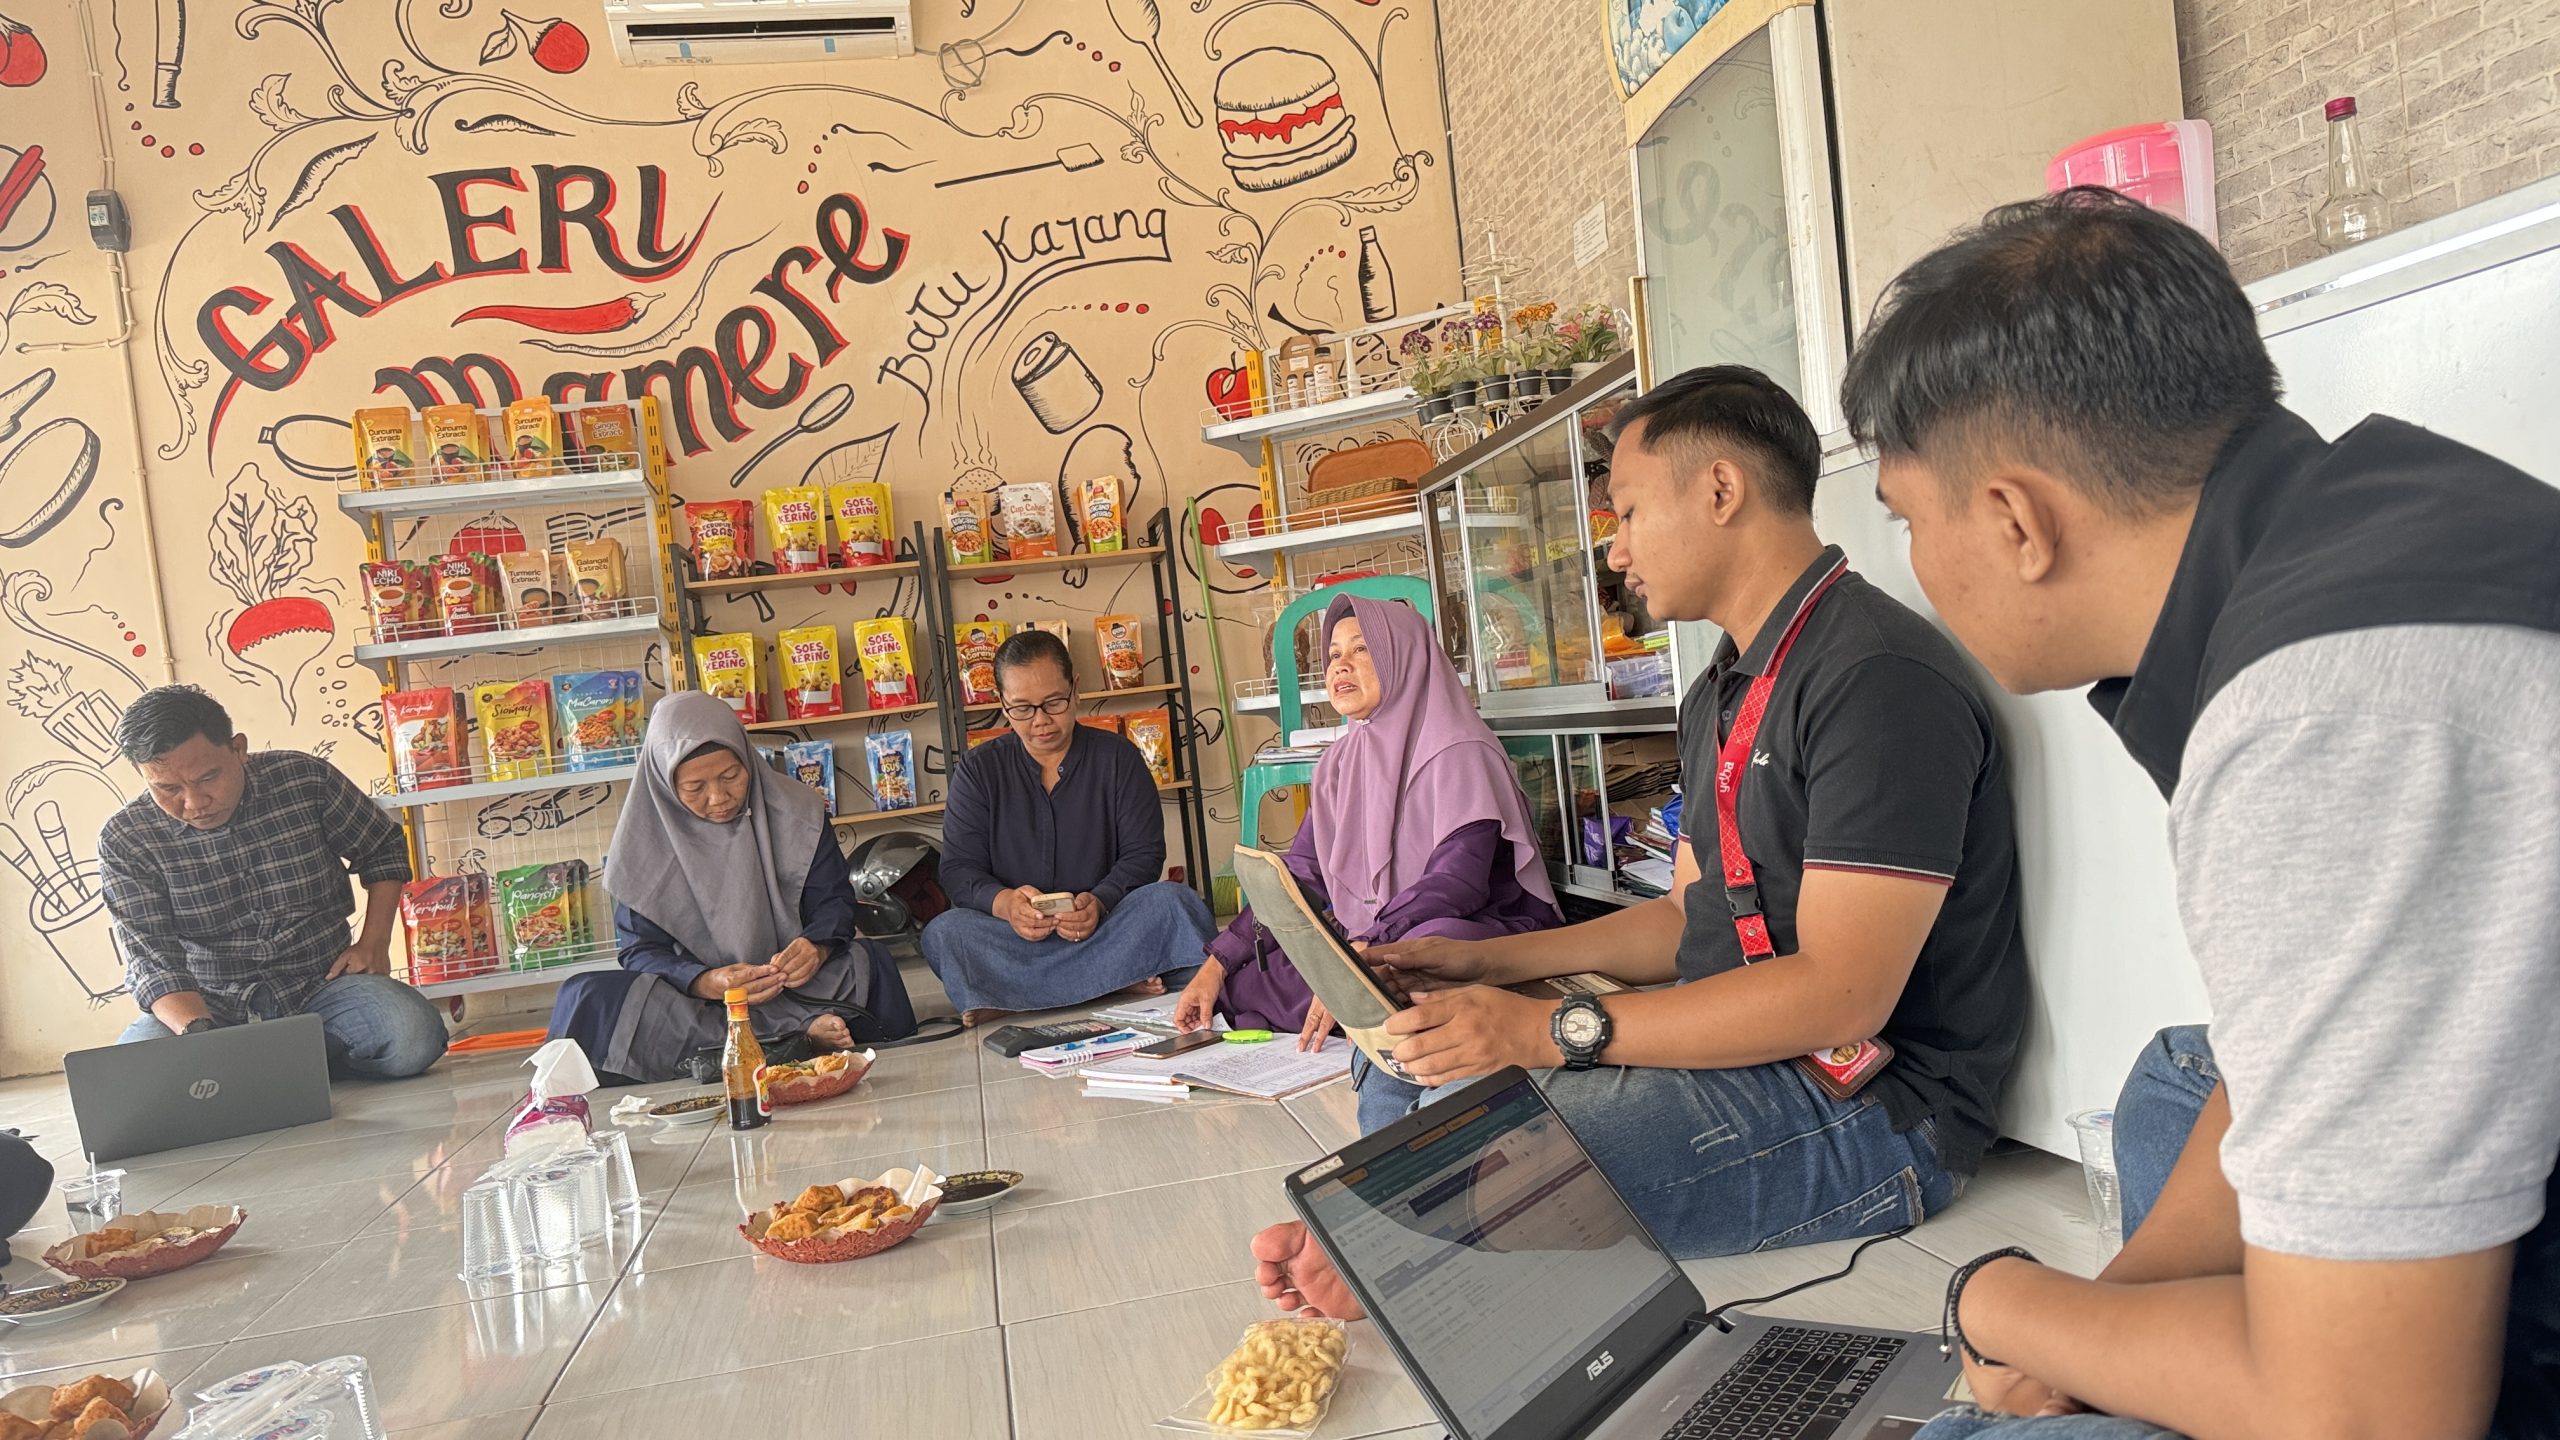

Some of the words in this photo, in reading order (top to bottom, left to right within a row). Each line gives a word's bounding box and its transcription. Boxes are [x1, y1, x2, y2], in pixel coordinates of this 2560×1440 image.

[197, 164, 724, 478] GALERI
[514, 416, 542, 425] Curcuma
[434, 424, 468, 433] Curcuma
[593, 421, 620, 431] Ginger
[368, 428, 402, 436] Curcuma
[436, 431, 466, 439] Extract
[592, 428, 623, 439] Extract
[371, 435, 401, 443] Extract
[781, 502, 811, 513] SOES
[844, 497, 874, 508] SOES
[1010, 504, 1024, 514] Cup
[698, 527, 737, 541] TERASI
[446, 561, 467, 570] NIKI
[576, 557, 609, 566] Galangal
[376, 569, 398, 578] NIKI
[443, 567, 471, 577] ECHO
[509, 569, 541, 577] Turmeric
[578, 564, 608, 573] Extract
[373, 576, 402, 585] ECHO
[511, 576, 540, 584] Extract
[868, 633, 895, 645] SOES
[794, 641, 824, 653] SOES
[709, 649, 739, 661] SOES
[492, 703, 532, 717] Siomay
[512, 885, 561, 905] Pangsit
[189, 1079, 220, 1100] hp
[1586, 1350, 1614, 1381] ASUS
